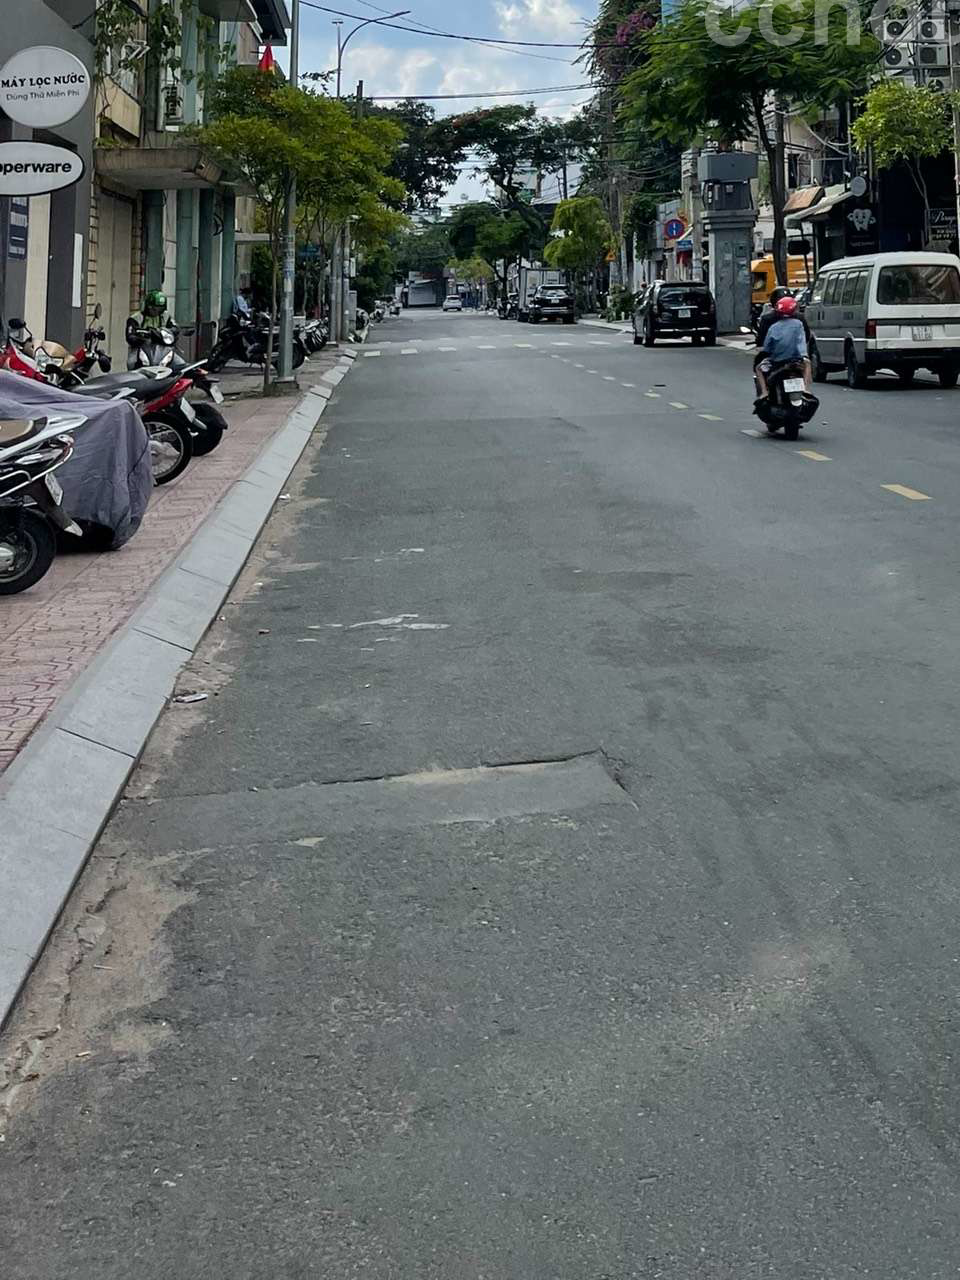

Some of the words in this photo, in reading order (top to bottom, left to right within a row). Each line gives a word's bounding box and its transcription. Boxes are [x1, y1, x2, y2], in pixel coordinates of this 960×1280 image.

[1, 76, 26, 88] MÁY
[29, 77, 51, 89] LỌC
[54, 72, 85, 85] NƯỚC
[0, 162, 72, 175] perware
